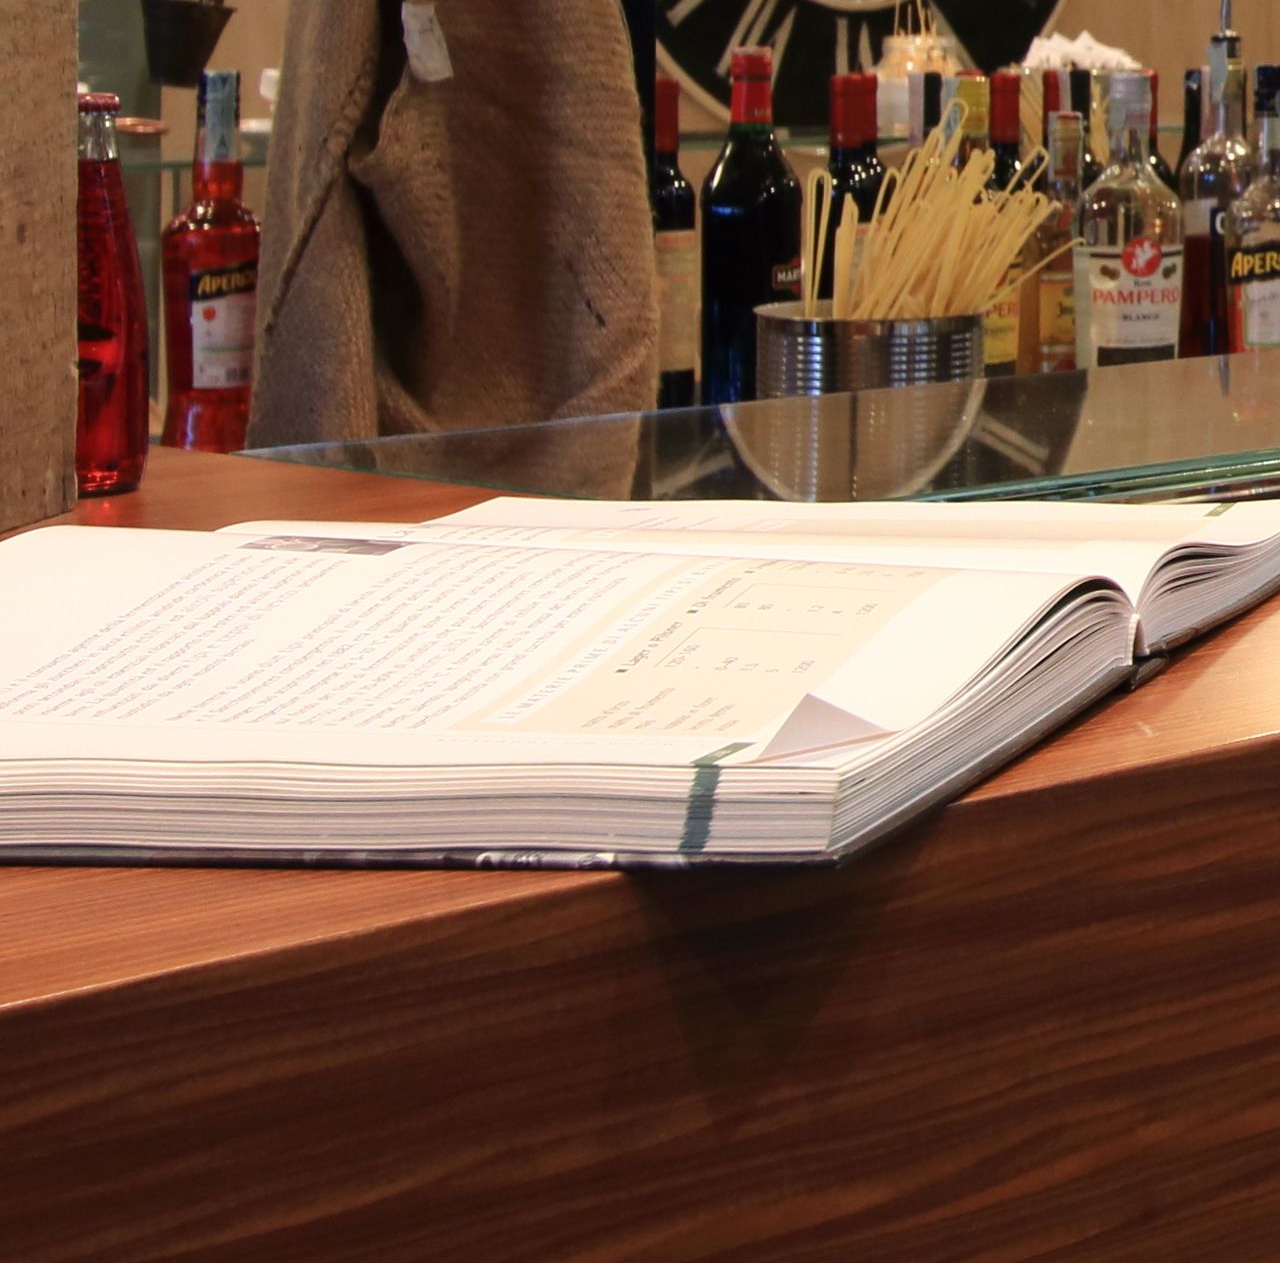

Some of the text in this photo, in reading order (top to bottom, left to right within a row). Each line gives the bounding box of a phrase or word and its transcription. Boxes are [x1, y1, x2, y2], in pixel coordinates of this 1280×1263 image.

[1092, 286, 1180, 306] PAMPERO
[701, 576, 741, 600] frumento
[620, 648, 651, 667] Lager
[649, 620, 683, 642] Pilsner
[664, 644, 700, 668] 120-160
